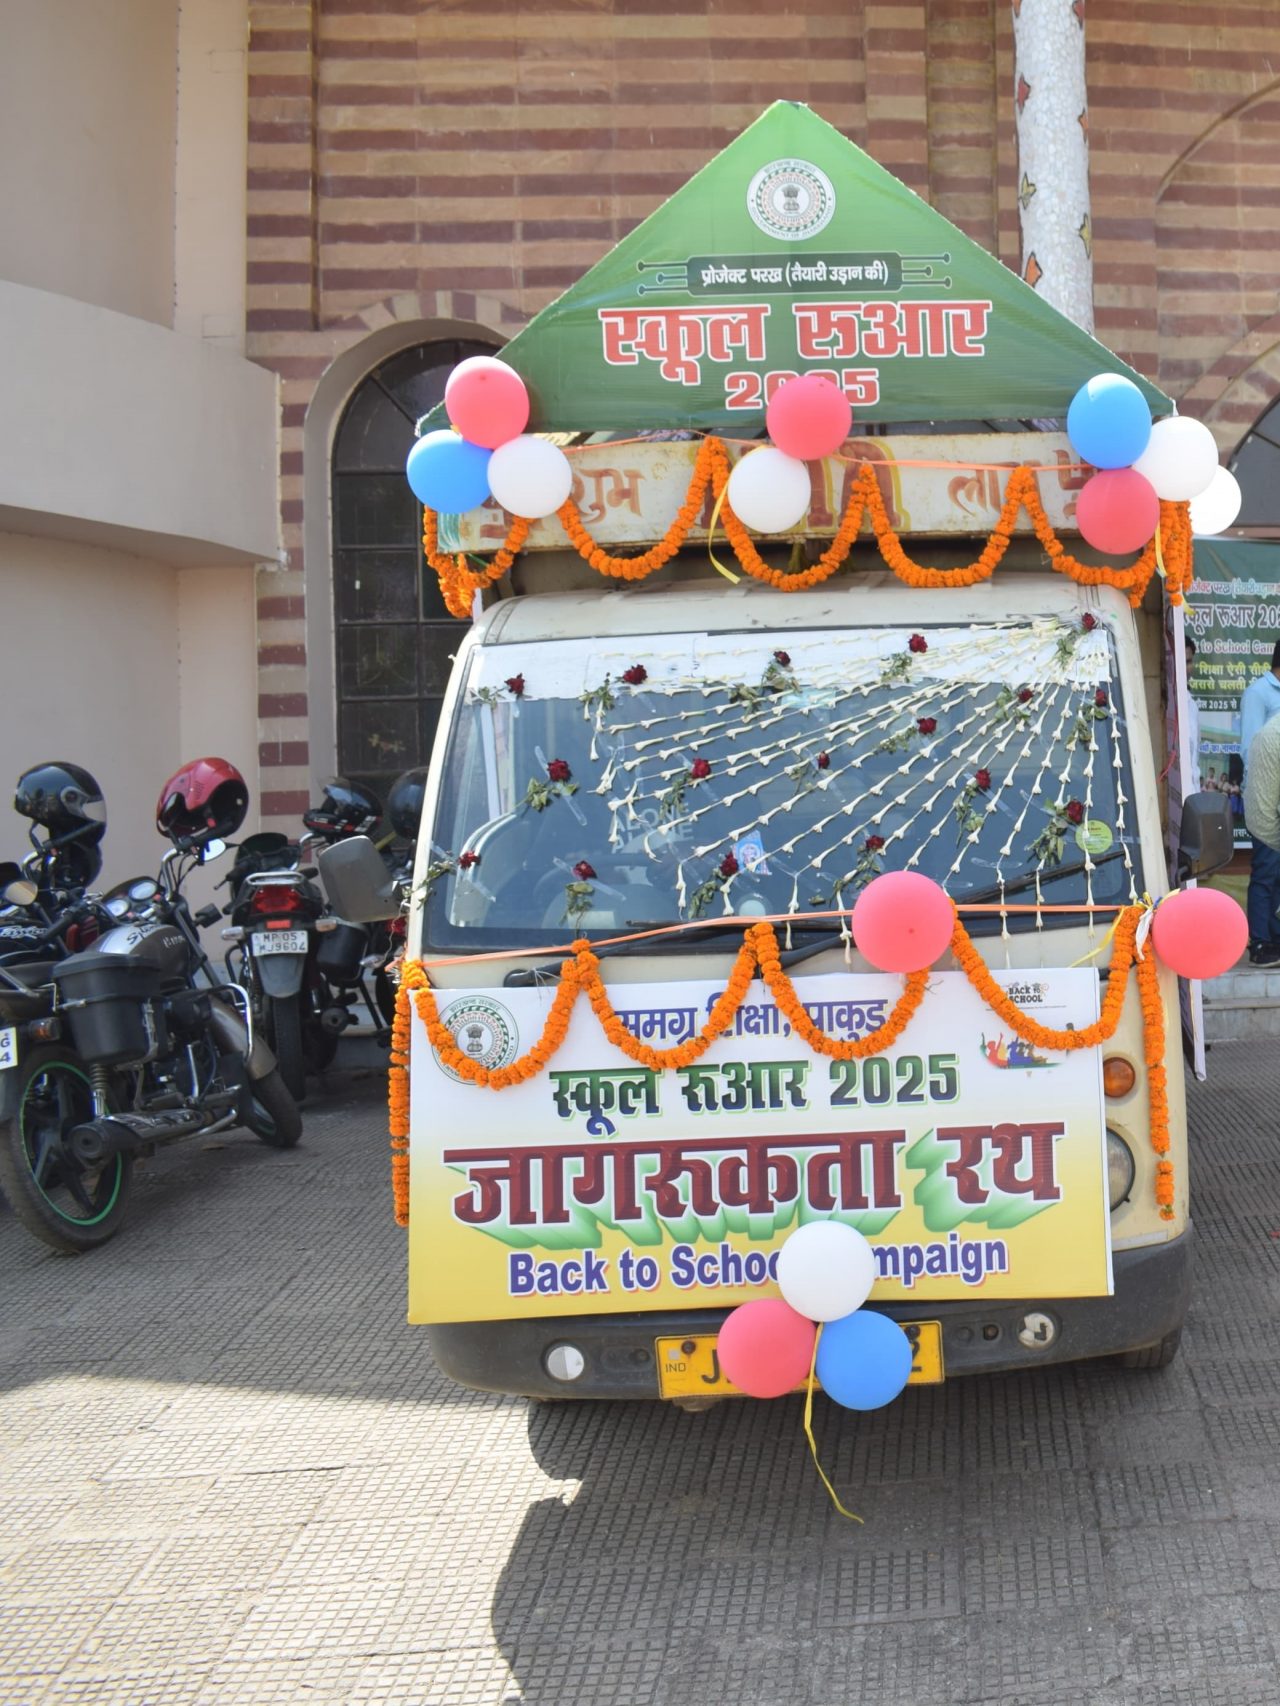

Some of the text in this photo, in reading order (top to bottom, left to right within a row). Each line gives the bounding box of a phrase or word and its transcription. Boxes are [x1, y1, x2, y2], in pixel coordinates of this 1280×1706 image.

[701, 259, 889, 287] प्रोजेक्ट परख (तैयारी उड़ान की)
[598, 303, 770, 386] स्कूल
[724, 367, 881, 411] 25
[1213, 638, 1250, 655] School
[1209, 700, 1229, 710] 2025
[1008, 986, 1031, 995] BACK
[549, 1067, 662, 1136] स्कूल
[829, 1053, 957, 1106] 2025
[443, 1121, 1066, 1226] जागरूकता रथ
[509, 1233, 1008, 1294] Back to Scho mpaign
[665, 1362, 687, 1374] IND
